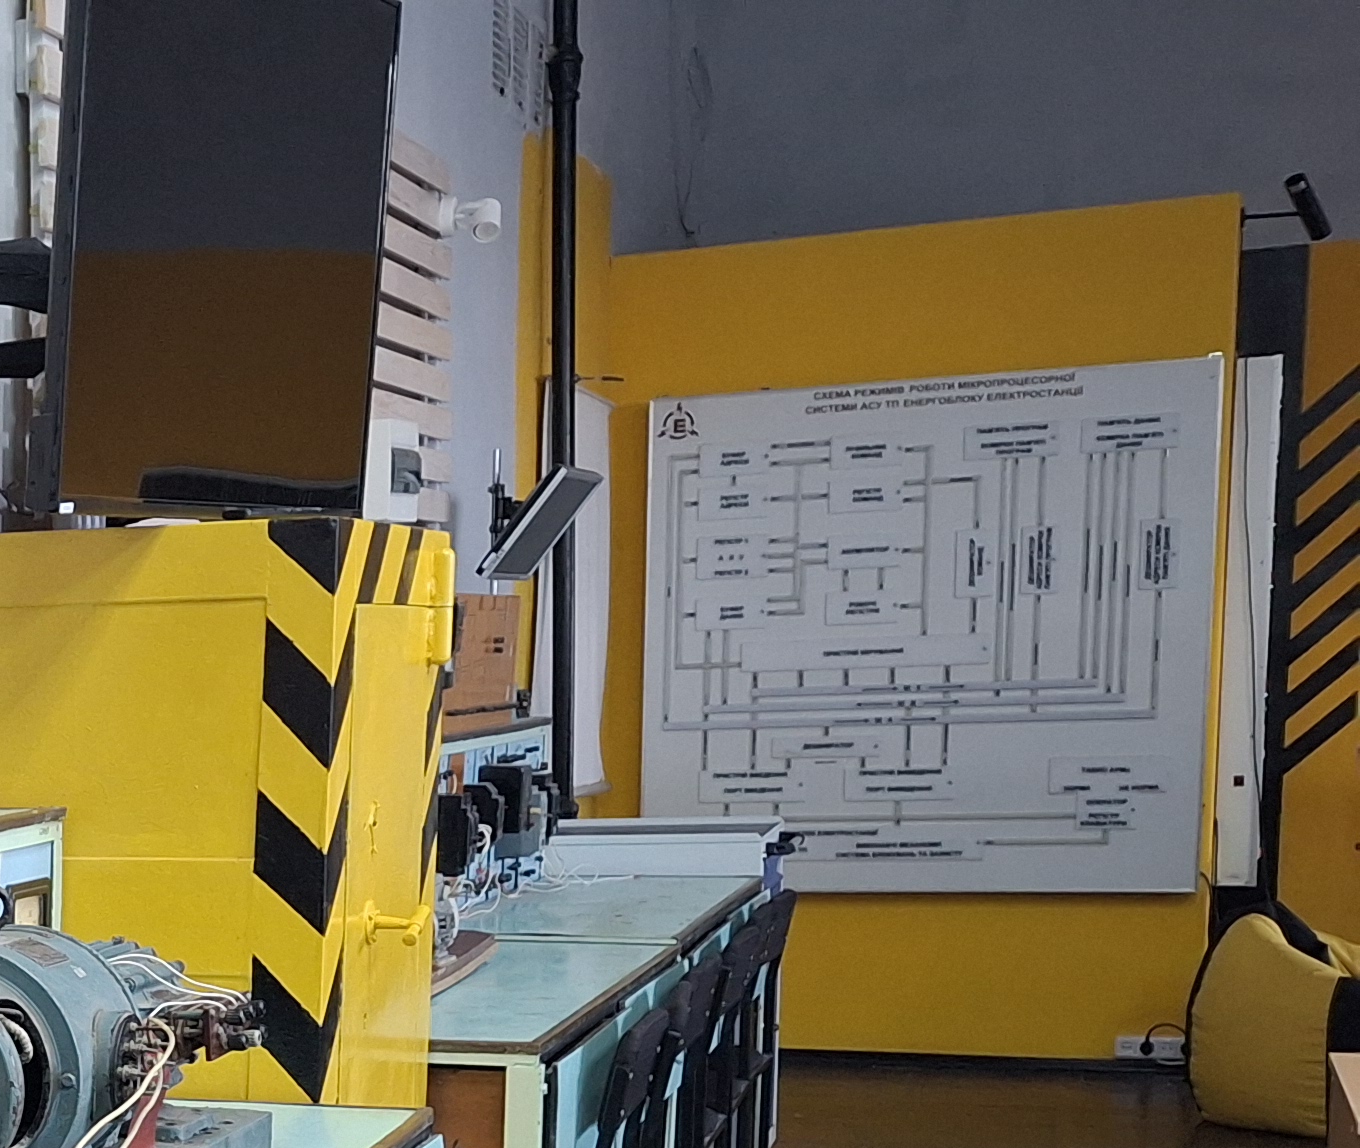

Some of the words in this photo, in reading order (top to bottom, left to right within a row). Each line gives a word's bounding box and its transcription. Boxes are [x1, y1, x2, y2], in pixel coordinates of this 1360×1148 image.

[805, 403, 858, 415] СИСТЕМИ
[860, 400, 882, 411] АСУ
[885, 399, 899, 409] ТП
[903, 393, 984, 408] ЕНЕРГОБЛОКУ
[986, 385, 1084, 402] ЕЛЕКТРОСТАНЦІЇ
[813, 390, 852, 401] СХЕМА
[854, 385, 905, 397] РЕЖИМІВ
[909, 381, 955, 393] РОБОТИ
[957, 372, 1076, 390] МІКРОПРОЦЕСОРНОЇ
